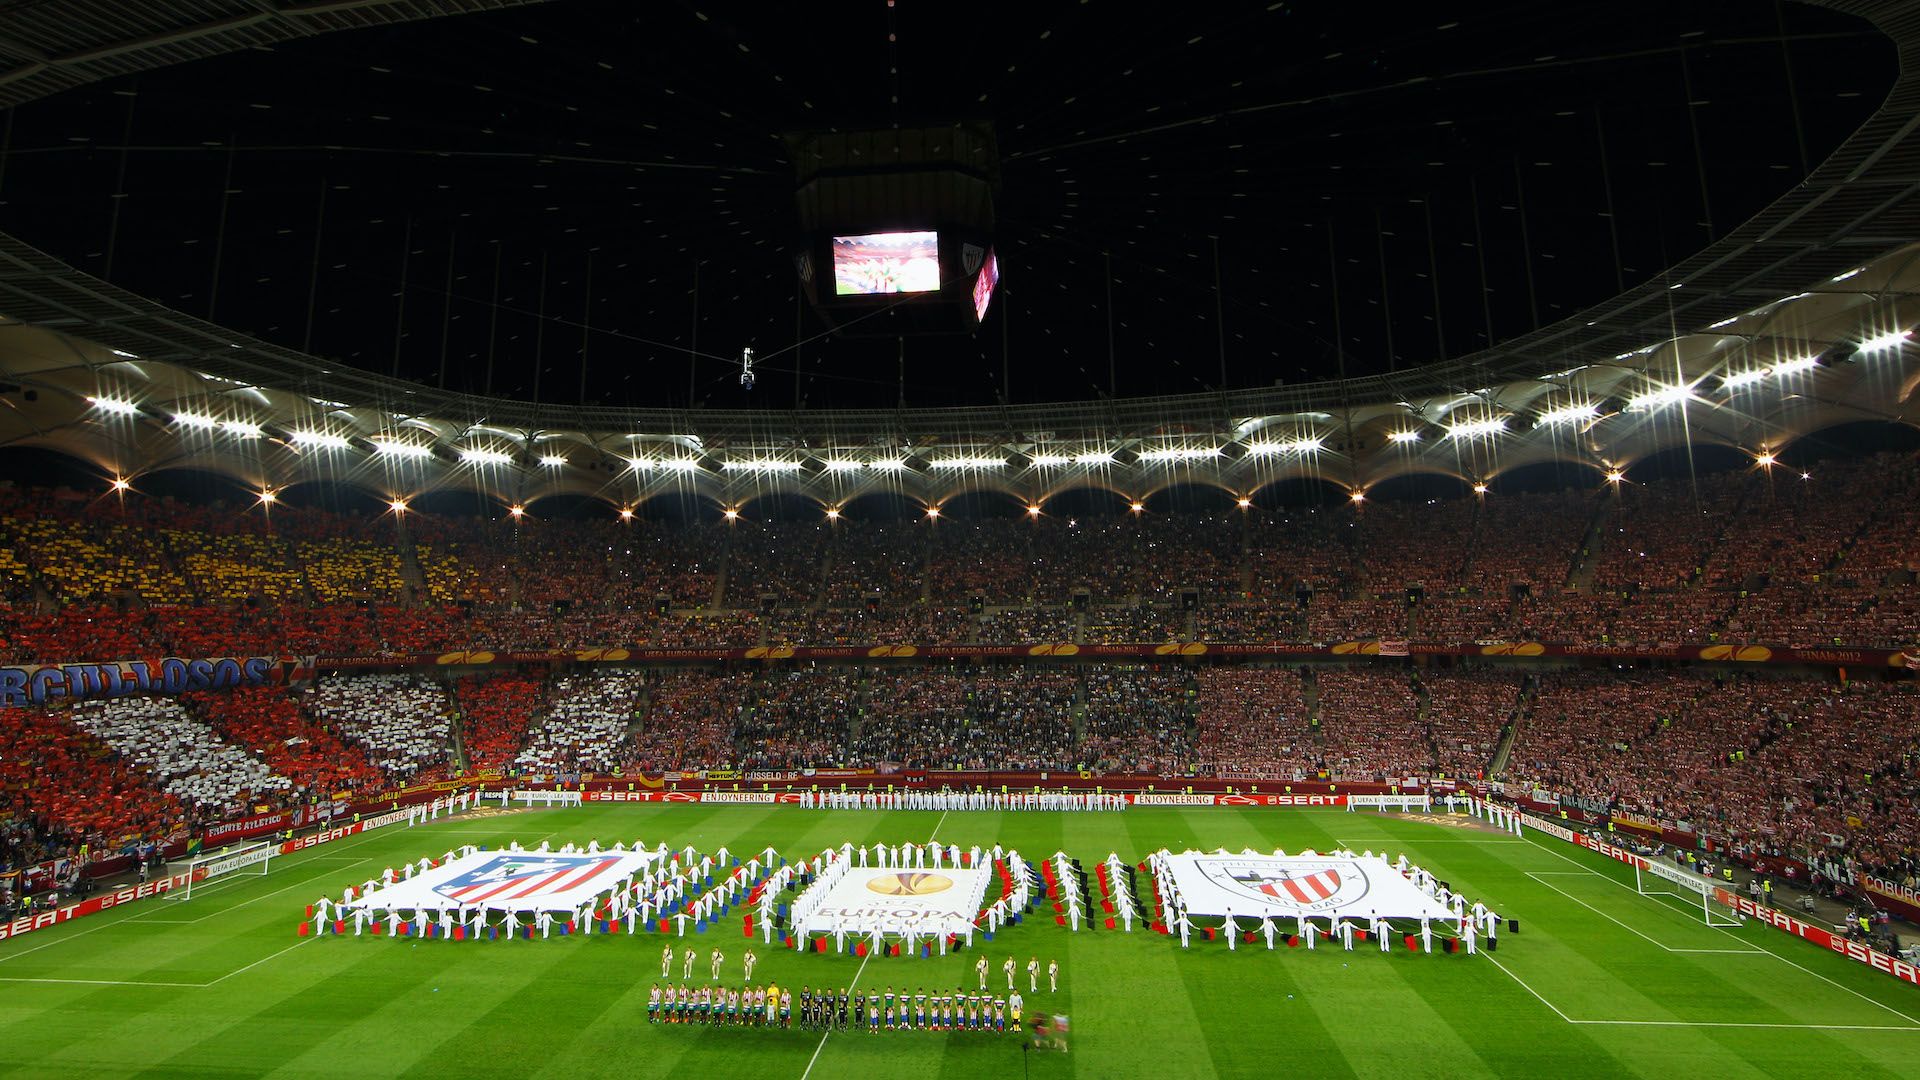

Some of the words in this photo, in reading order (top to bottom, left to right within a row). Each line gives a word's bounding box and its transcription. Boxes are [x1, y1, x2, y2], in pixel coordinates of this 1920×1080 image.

[1838, 651, 1862, 662] 2012
[600, 793, 654, 801] SEAT
[705, 793, 771, 802] ENJOYNEERING
[1139, 795, 1209, 804] ENJOYNEERING
[1278, 795, 1339, 805] SEAT
[1523, 814, 1570, 840] ENJOYNEERING
[304, 824, 356, 848] SEAT
[1587, 838, 1636, 865] SEAT
[212, 864, 229, 874] UEFA
[116, 872, 190, 905] SEAT
[816, 907, 965, 919] EUROPA
[1739, 898, 1810, 938] SEAT
[1846, 941, 1920, 984] SEA
